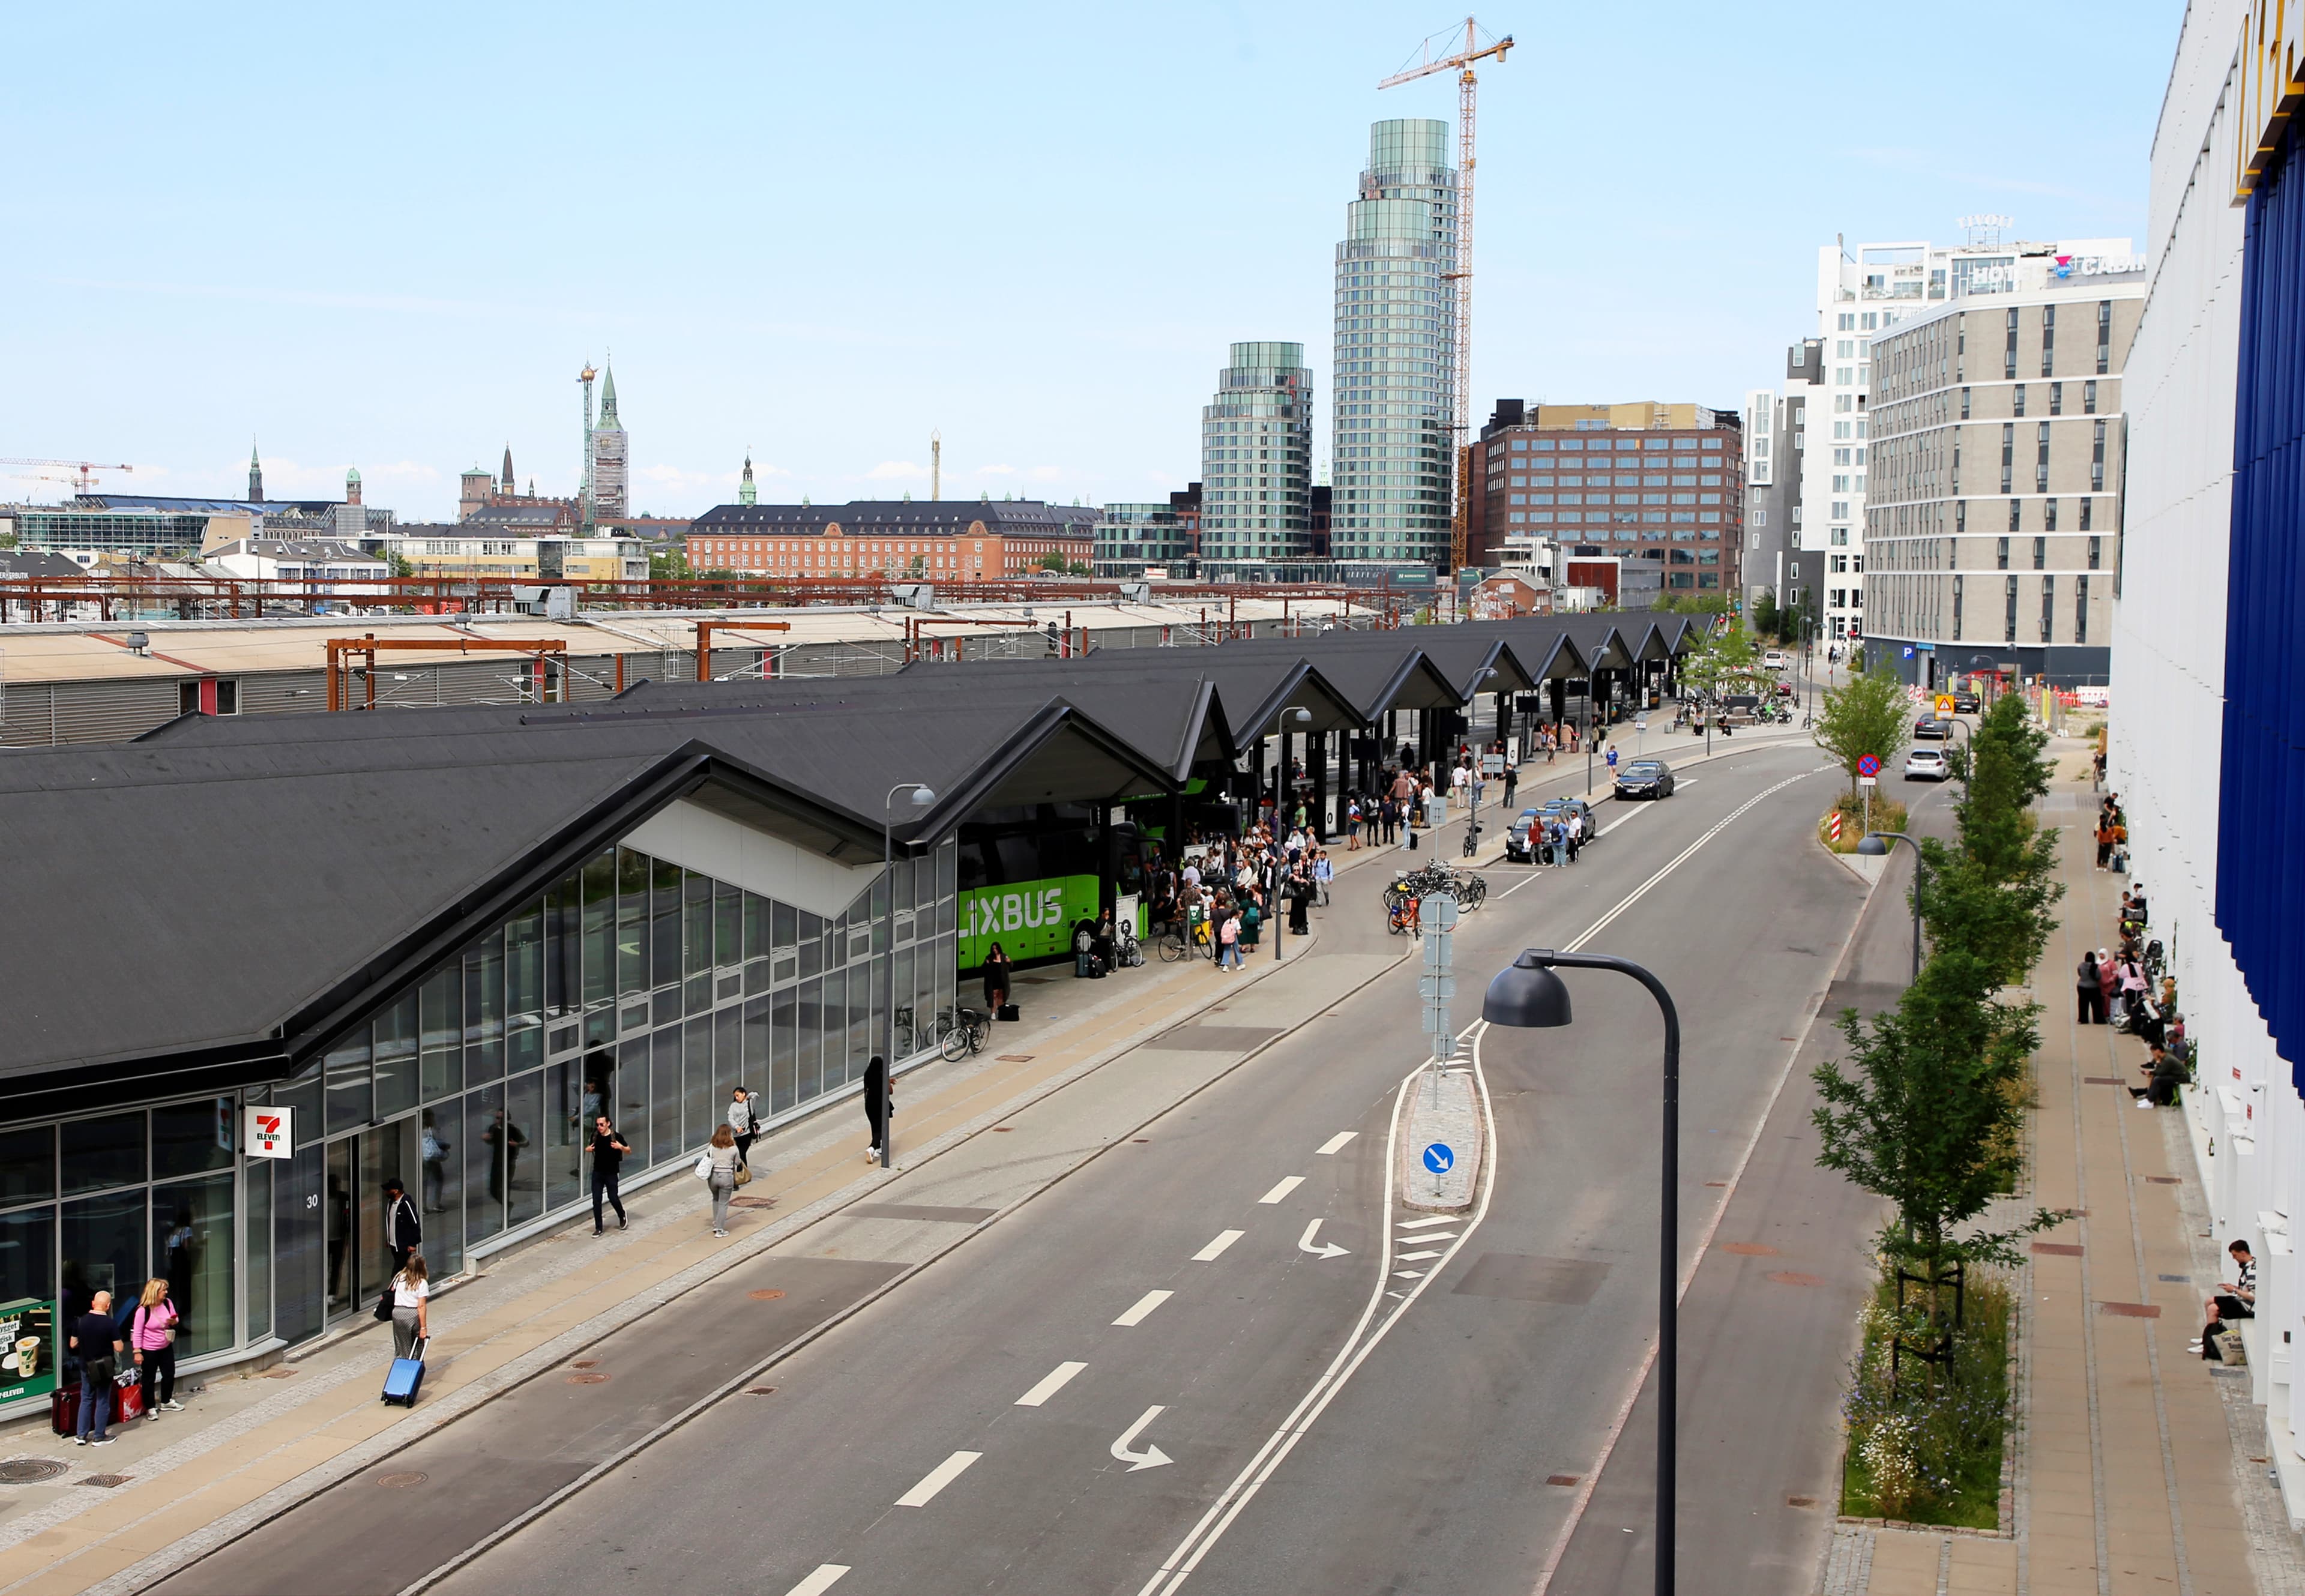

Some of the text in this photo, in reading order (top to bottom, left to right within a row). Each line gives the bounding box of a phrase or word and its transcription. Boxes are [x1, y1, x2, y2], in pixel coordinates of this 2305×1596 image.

[1904, 648, 1912, 657] P
[257, 1116, 280, 1150] 7
[307, 1194, 318, 1209] 30
